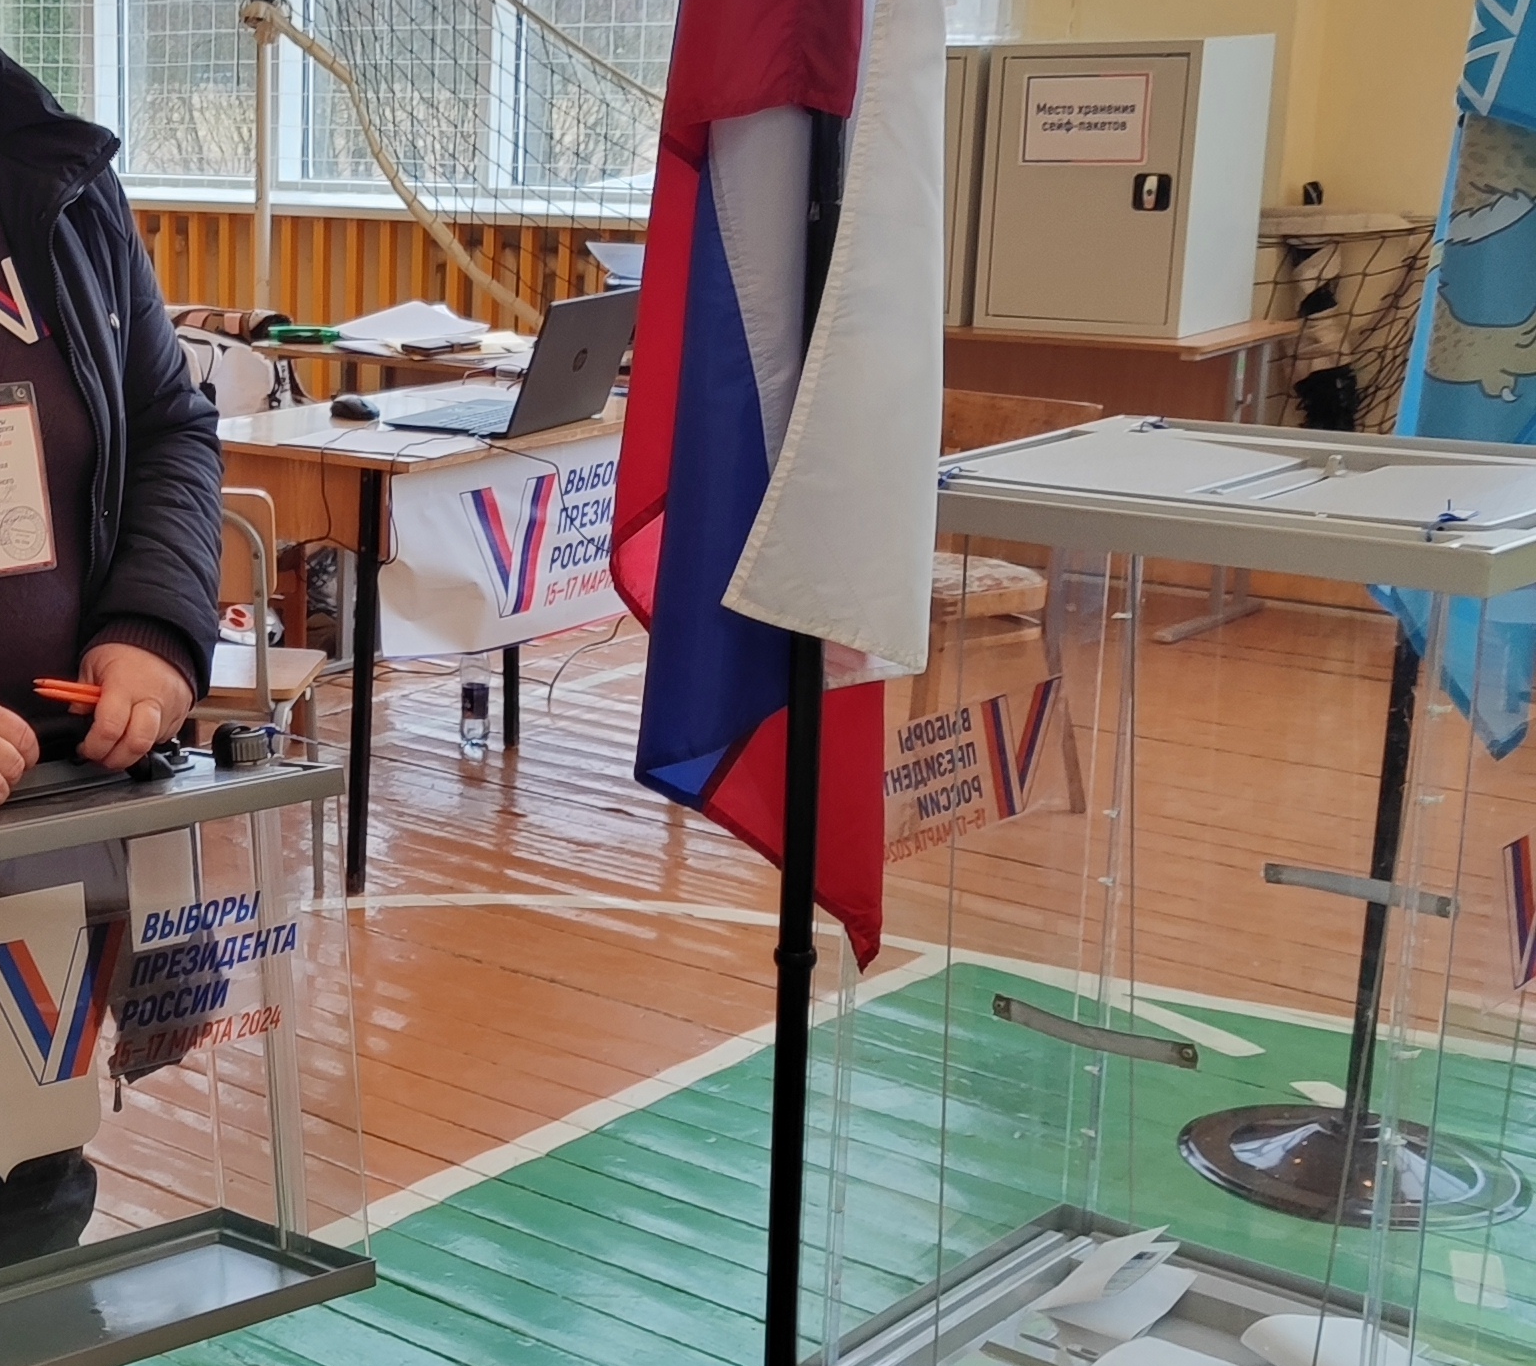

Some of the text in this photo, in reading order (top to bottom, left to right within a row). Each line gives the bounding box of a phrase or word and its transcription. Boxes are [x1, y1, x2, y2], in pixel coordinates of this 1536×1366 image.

[1036, 103, 1136, 117] Место хранения
[1042, 118, 1127, 134] сейф-пакетов
[564, 460, 616, 496] ВЫБО
[557, 496, 613, 534] ПРЕЗИ
[140, 890, 262, 944] ВЫБОРЫ
[129, 922, 297, 988] ПРЕЗИДЕНТА
[119, 979, 230, 1031] РОССИИ
[167, 1016, 233, 1056] МАРТА
[237, 1004, 282, 1038] 2024
